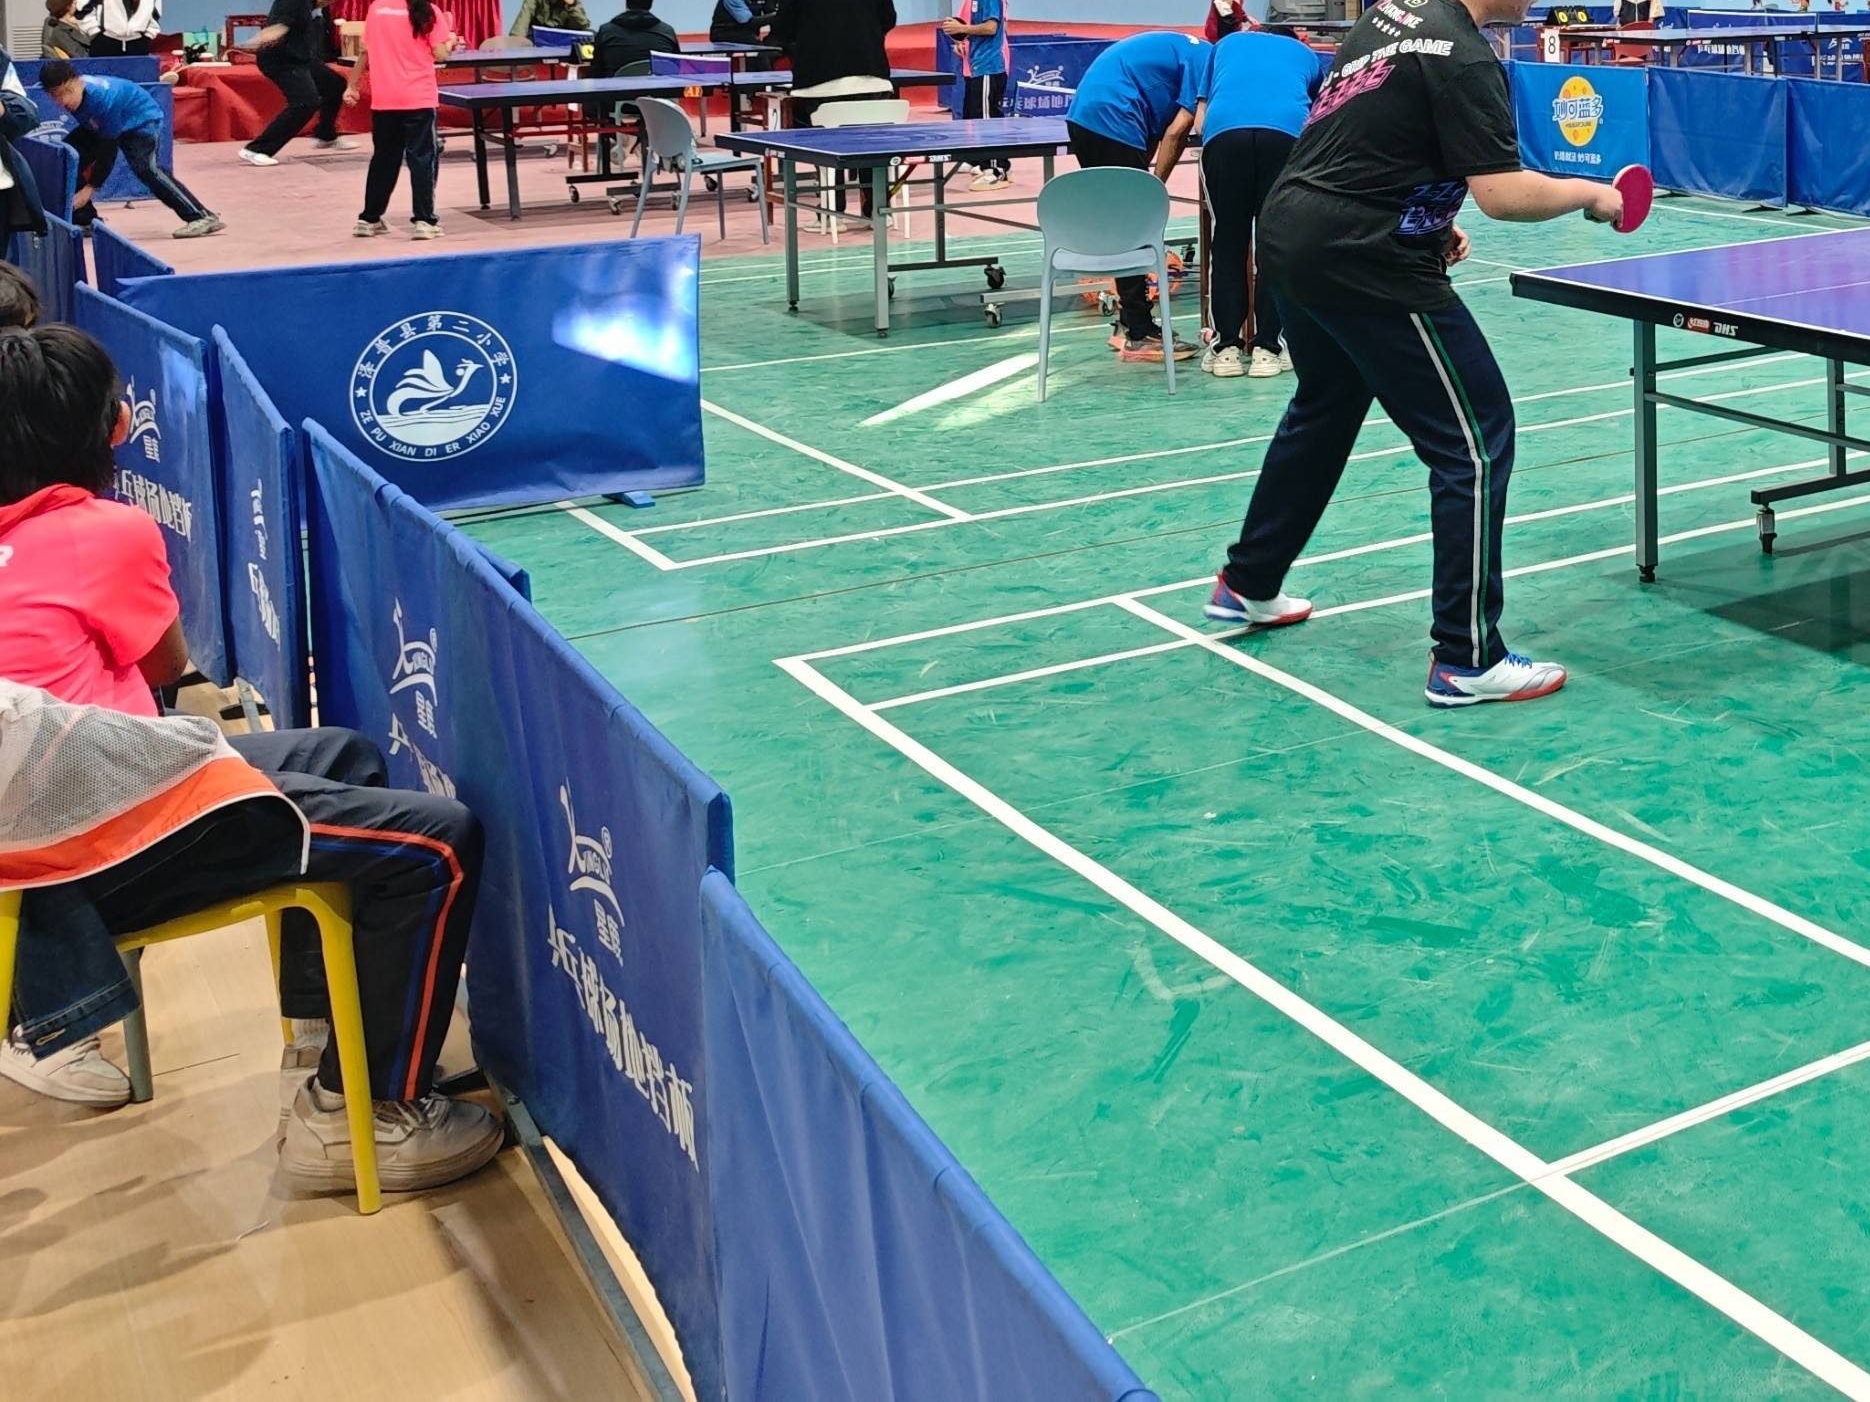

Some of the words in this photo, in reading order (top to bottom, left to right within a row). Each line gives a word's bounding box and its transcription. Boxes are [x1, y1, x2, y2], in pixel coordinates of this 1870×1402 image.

[1400, 38, 1454, 57] GAME
[1549, 35, 1556, 54] 8
[1713, 322, 1738, 336] DHS
[358, 314, 509, 379] 泽普县第二小学
[360, 410, 373, 424] ZE
[370, 427, 387, 442] PU
[388, 440, 417, 456] XIAN
[424, 447, 437, 457] DI
[445, 442, 462, 454] ER
[466, 421, 491, 444] XIAO
[490, 396, 506, 418] XUE
